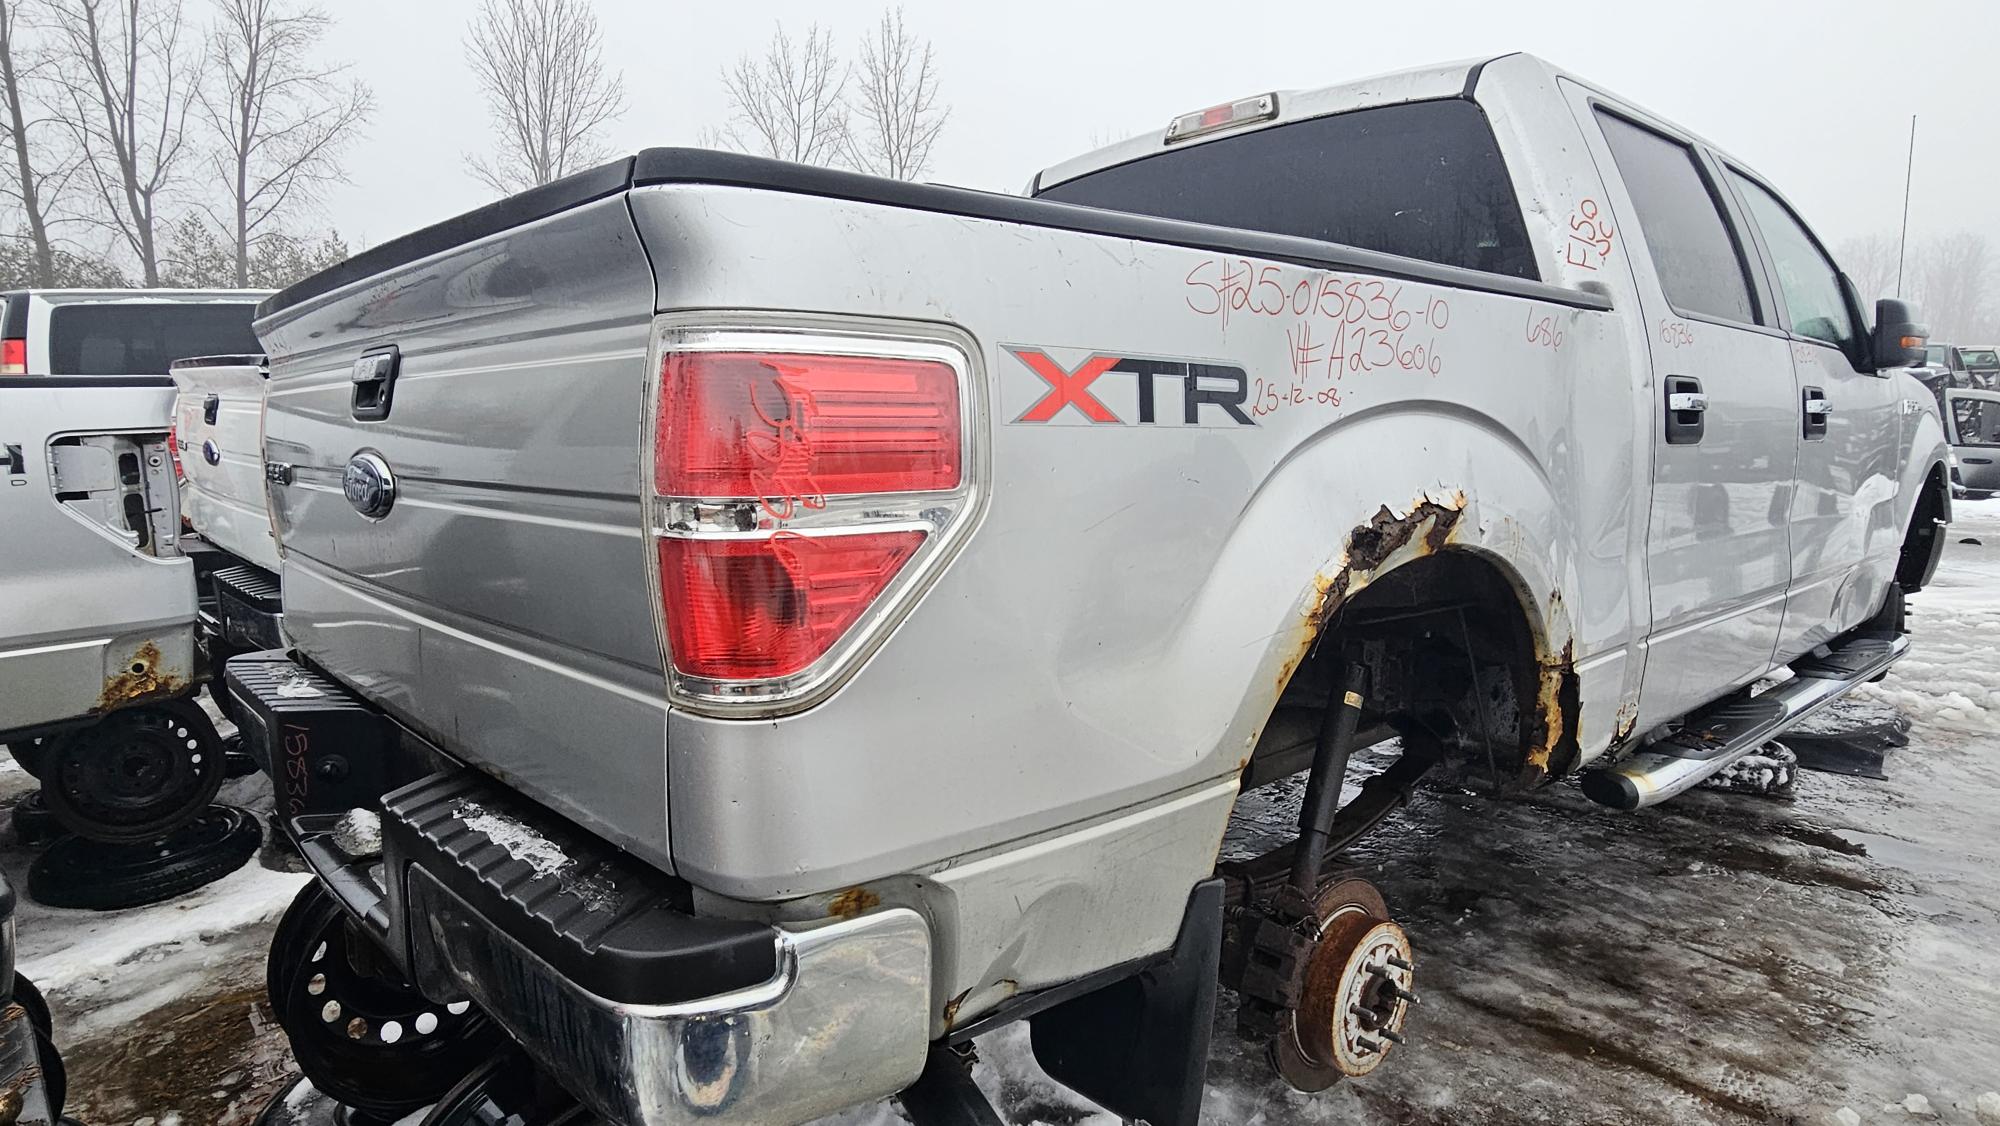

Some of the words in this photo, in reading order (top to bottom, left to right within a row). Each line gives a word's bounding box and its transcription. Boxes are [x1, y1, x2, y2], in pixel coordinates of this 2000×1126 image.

[1566, 199, 1598, 271] F150
[1526, 305, 1563, 353] 686
[1001, 345, 1260, 426] XTR
[346, 464, 371, 502] Ford
